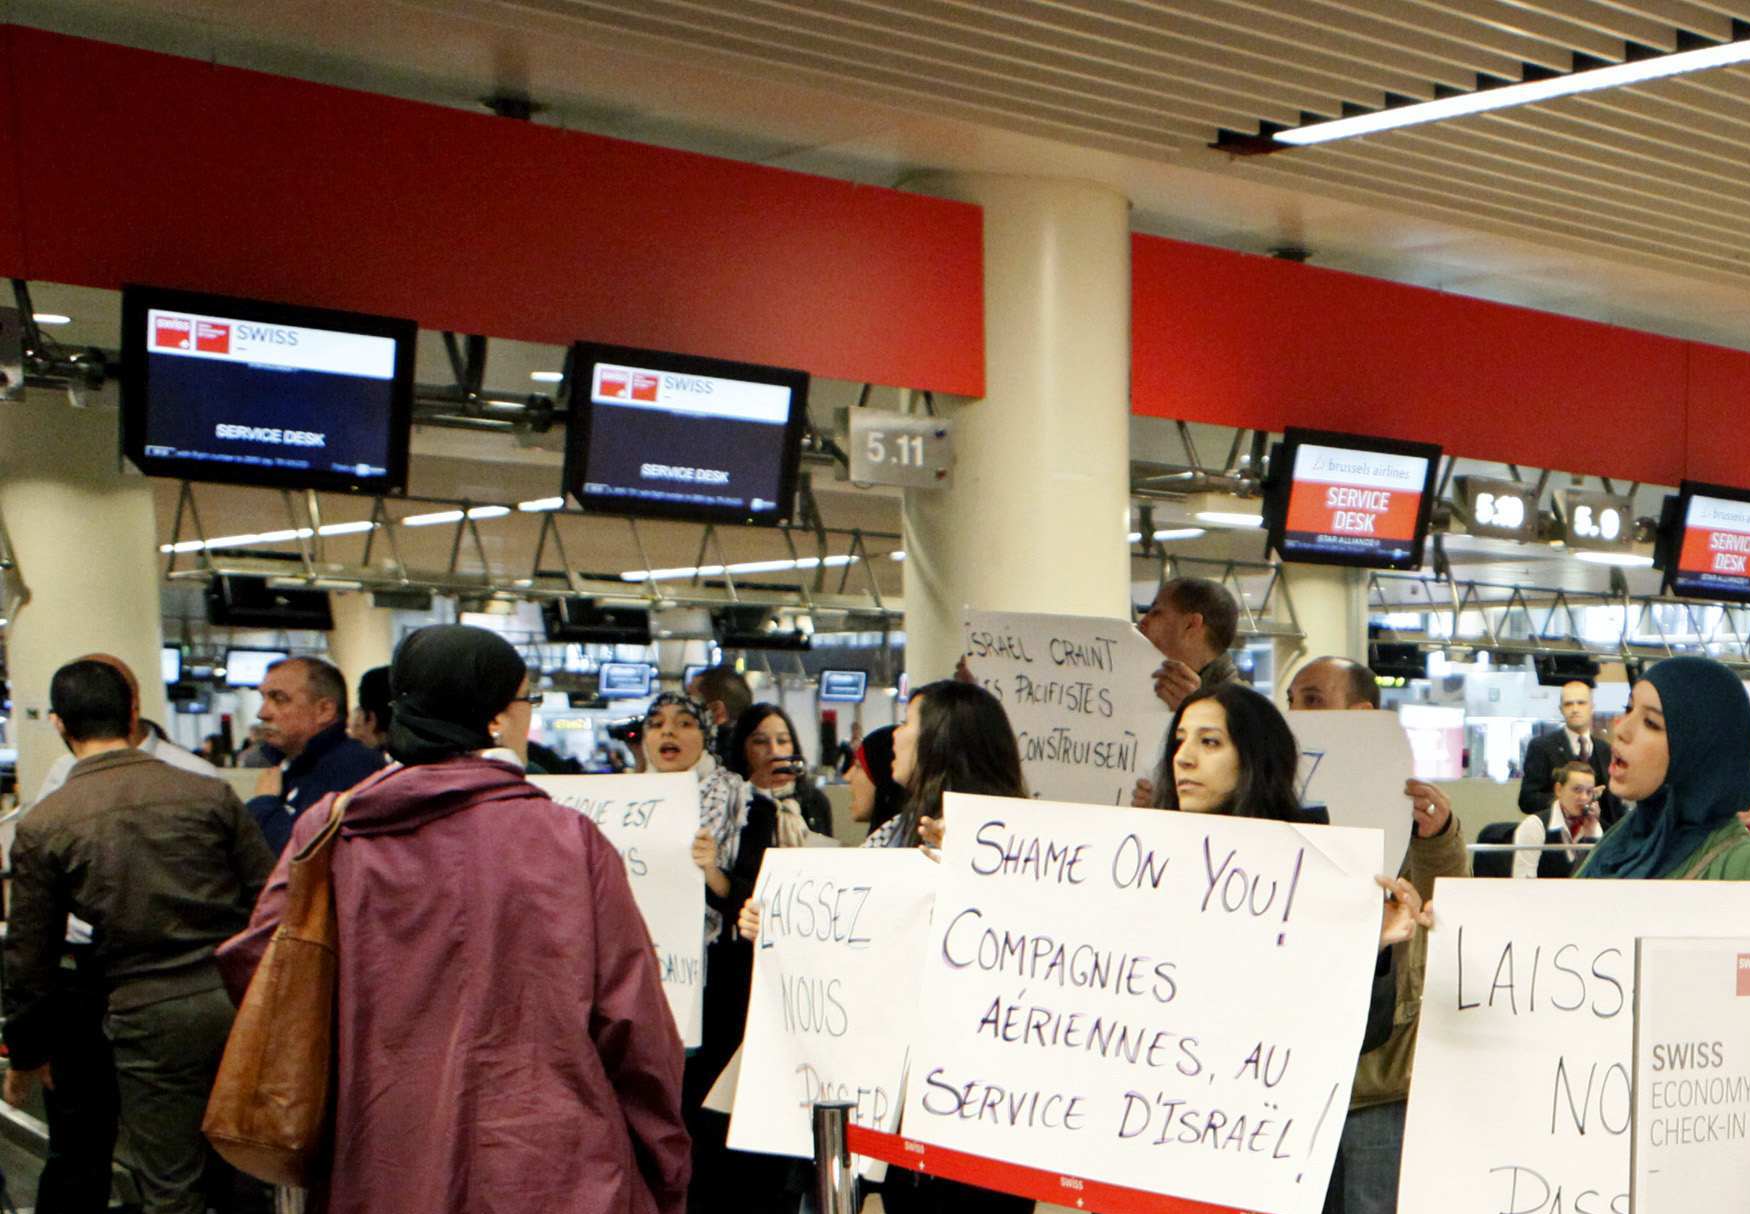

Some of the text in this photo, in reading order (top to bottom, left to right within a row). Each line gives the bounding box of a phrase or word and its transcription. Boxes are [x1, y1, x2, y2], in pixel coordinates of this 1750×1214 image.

[237, 323, 299, 346] SWISS
[664, 374, 715, 394] SWISS
[215, 423, 326, 447] SERVICE DESK
[865, 432, 924, 467] 5.11
[641, 463, 730, 486] SERVICE DESK
[1328, 458, 1410, 480] brussels airlines
[1328, 487, 1391, 511] SERVICE
[1334, 510, 1376, 533] DESK
[1714, 553, 1747, 573] DESK
[1049, 636, 1118, 672] CRAINT
[1014, 673, 1114, 719] PACIFISTES
[622, 798, 665, 828] EST
[971, 820, 1305, 947] SHAME ON YOU!
[761, 872, 873, 949] LAISSEZ
[941, 908, 1177, 1003] COMPAGNIES
[1457, 925, 1625, 1019] LAISS
[780, 973, 850, 1037] NOUS
[976, 988, 1291, 1089] AÉRIENNES, AU
[1652, 1041, 1723, 1072] SWISS
[921, 1068, 1086, 1132] SERVICE
[1551, 1056, 1632, 1136] NO
[1650, 1112, 1746, 1147] CHECK-IN
[1060, 1175, 1084, 1190] swiss
